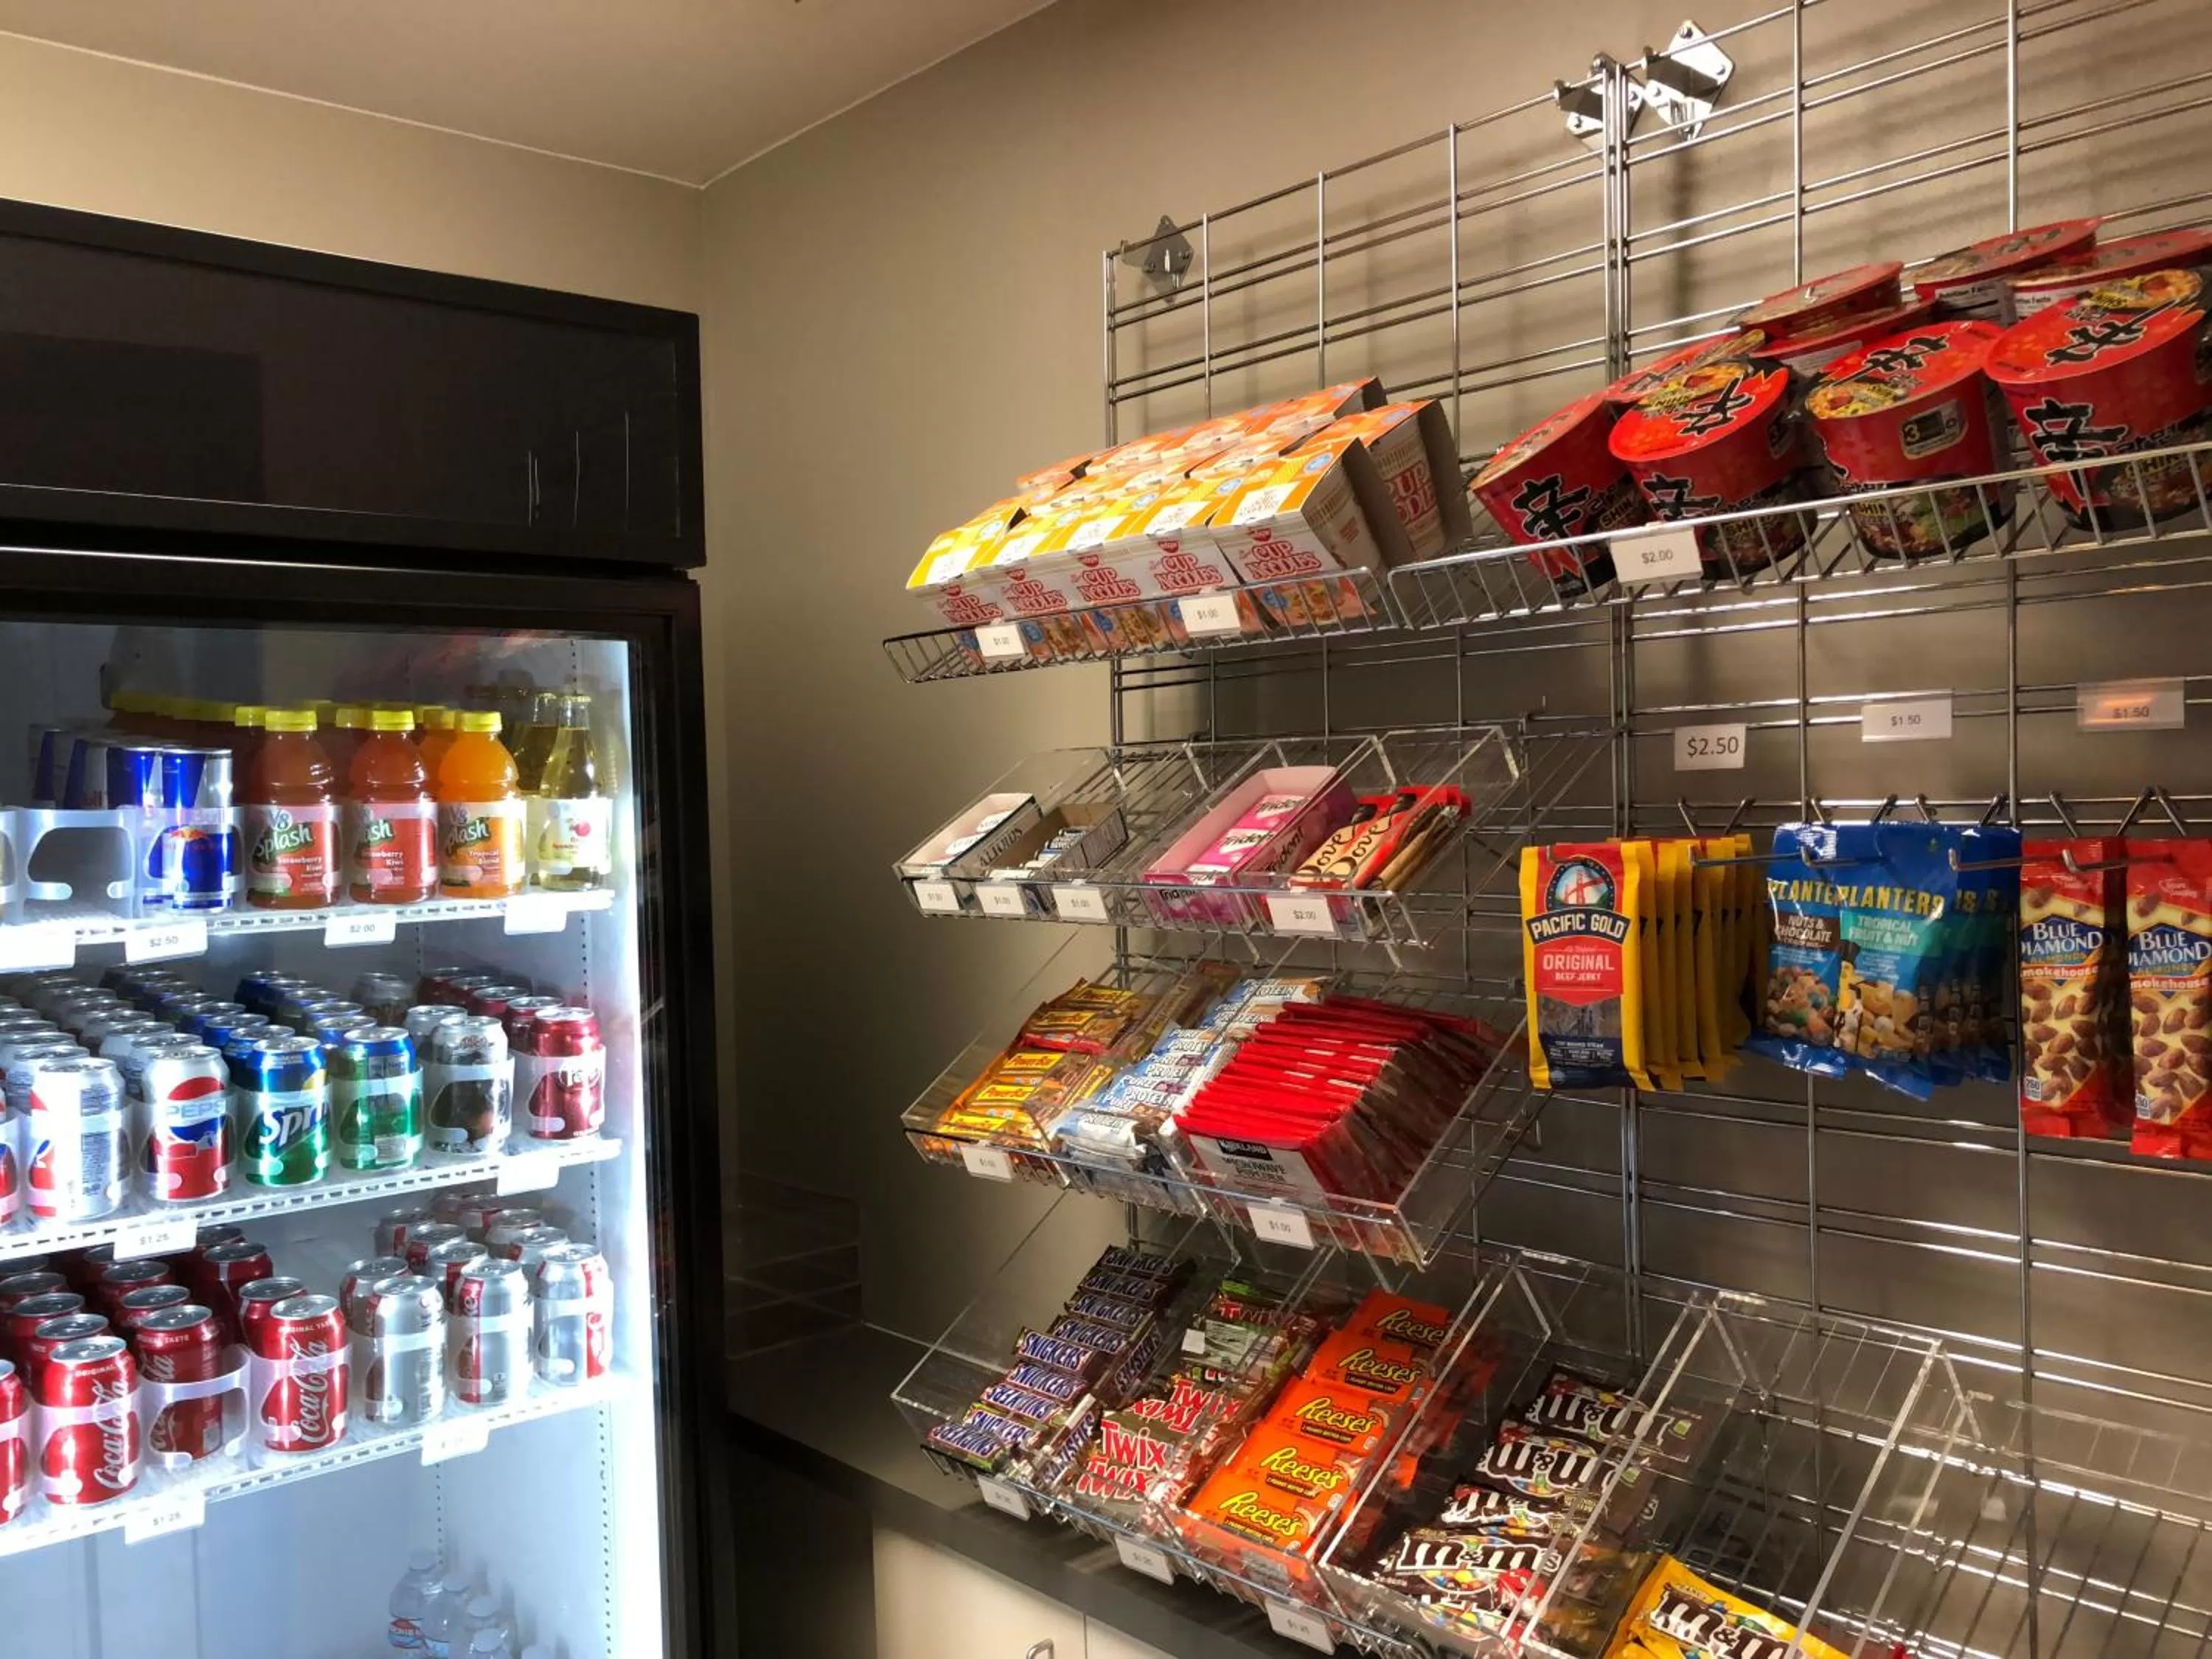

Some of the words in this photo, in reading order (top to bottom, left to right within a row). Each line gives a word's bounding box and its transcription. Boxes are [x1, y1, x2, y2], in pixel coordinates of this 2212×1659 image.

[1251, 540, 1293, 560] CUP
[1641, 549, 1674, 565] $2.00
[1161, 553, 1198, 572] CUP
[1082, 568, 1117, 585] CUP
[1891, 714, 1921, 726] $1.50
[1687, 736, 1739, 757] $2.50
[1836, 884, 1945, 918] PLANTERS
[1531, 914, 1586, 939] PACIFIC
[1590, 914, 1624, 939] GOLD
[2033, 922, 2081, 941] BLUE
[150, 935, 179, 947] $2.50
[2139, 931, 2188, 951] BLUE
[1543, 954, 1615, 970] ORIGINAL
[1023, 1332, 1088, 1371] SNICKERS
